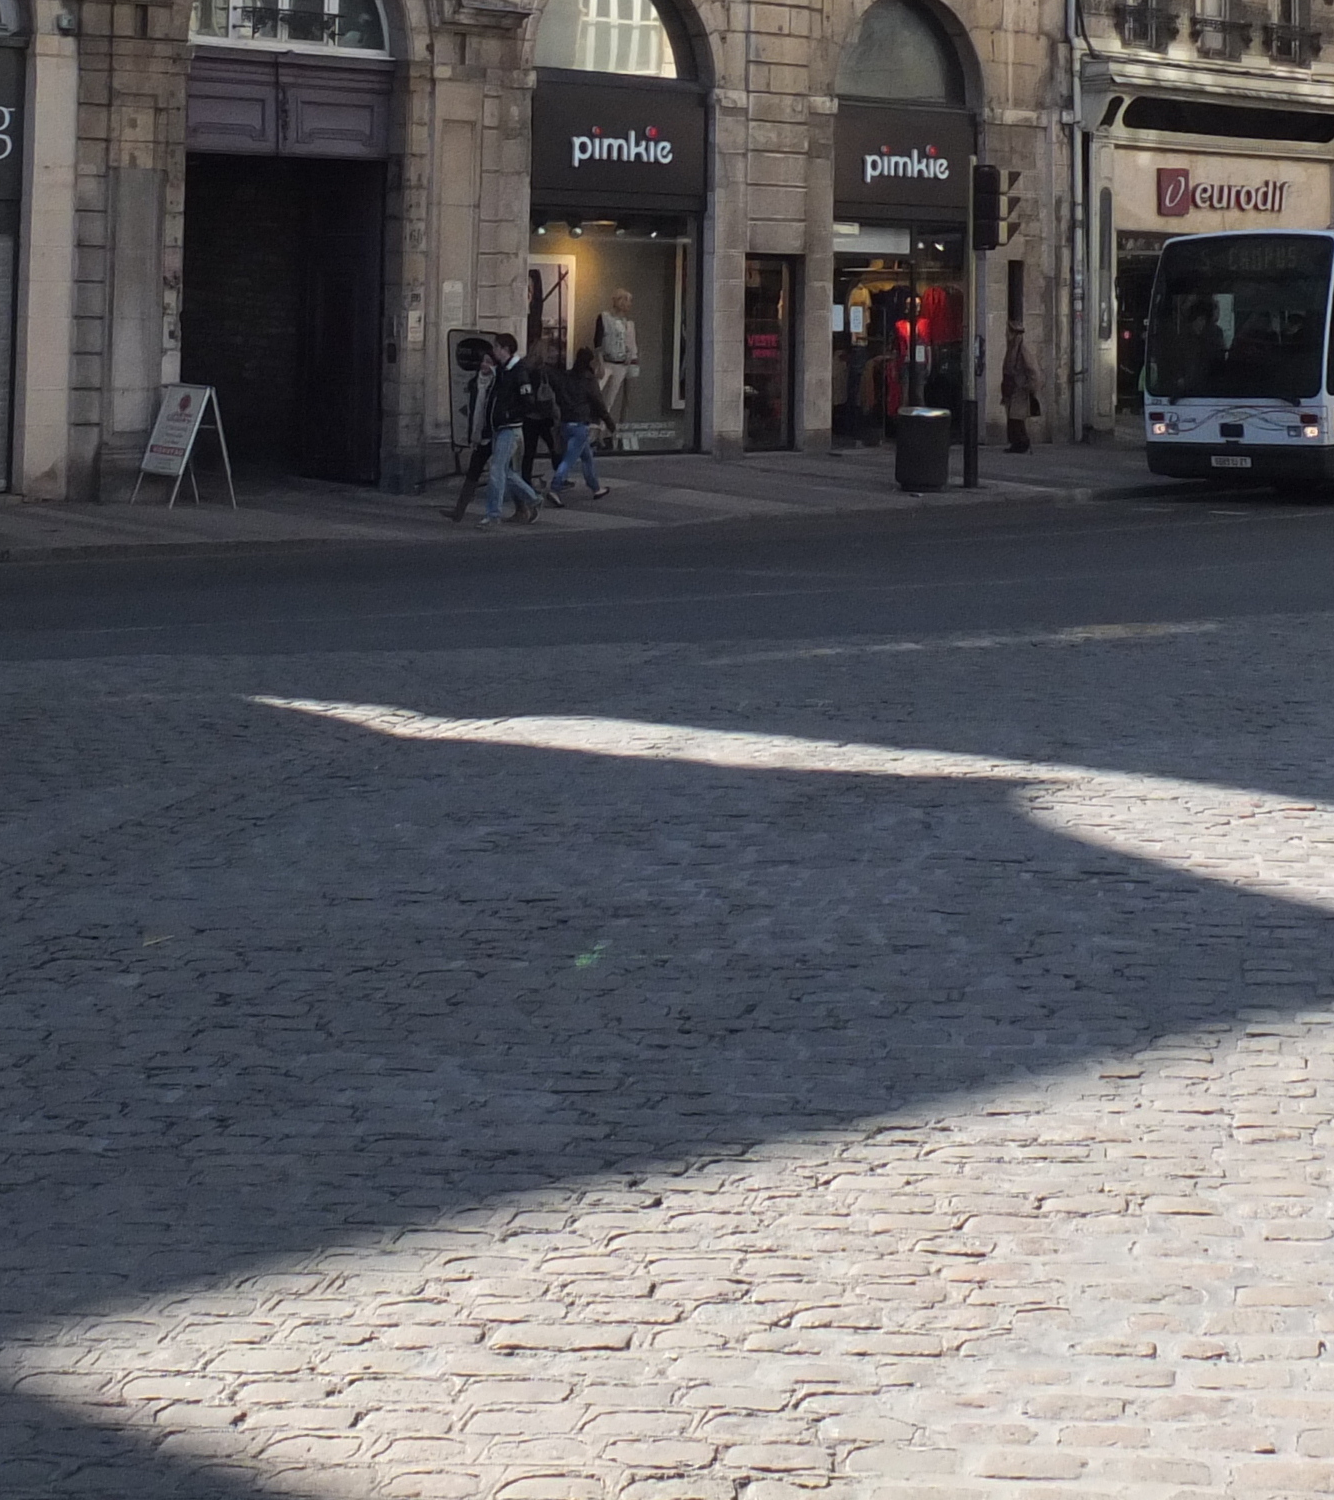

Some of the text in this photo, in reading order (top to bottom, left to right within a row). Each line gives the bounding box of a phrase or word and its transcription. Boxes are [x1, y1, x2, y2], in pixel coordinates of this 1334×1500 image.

[571, 125, 673, 168] pimkie
[863, 144, 951, 184] pimkie
[1190, 178, 1291, 213] eurodif
